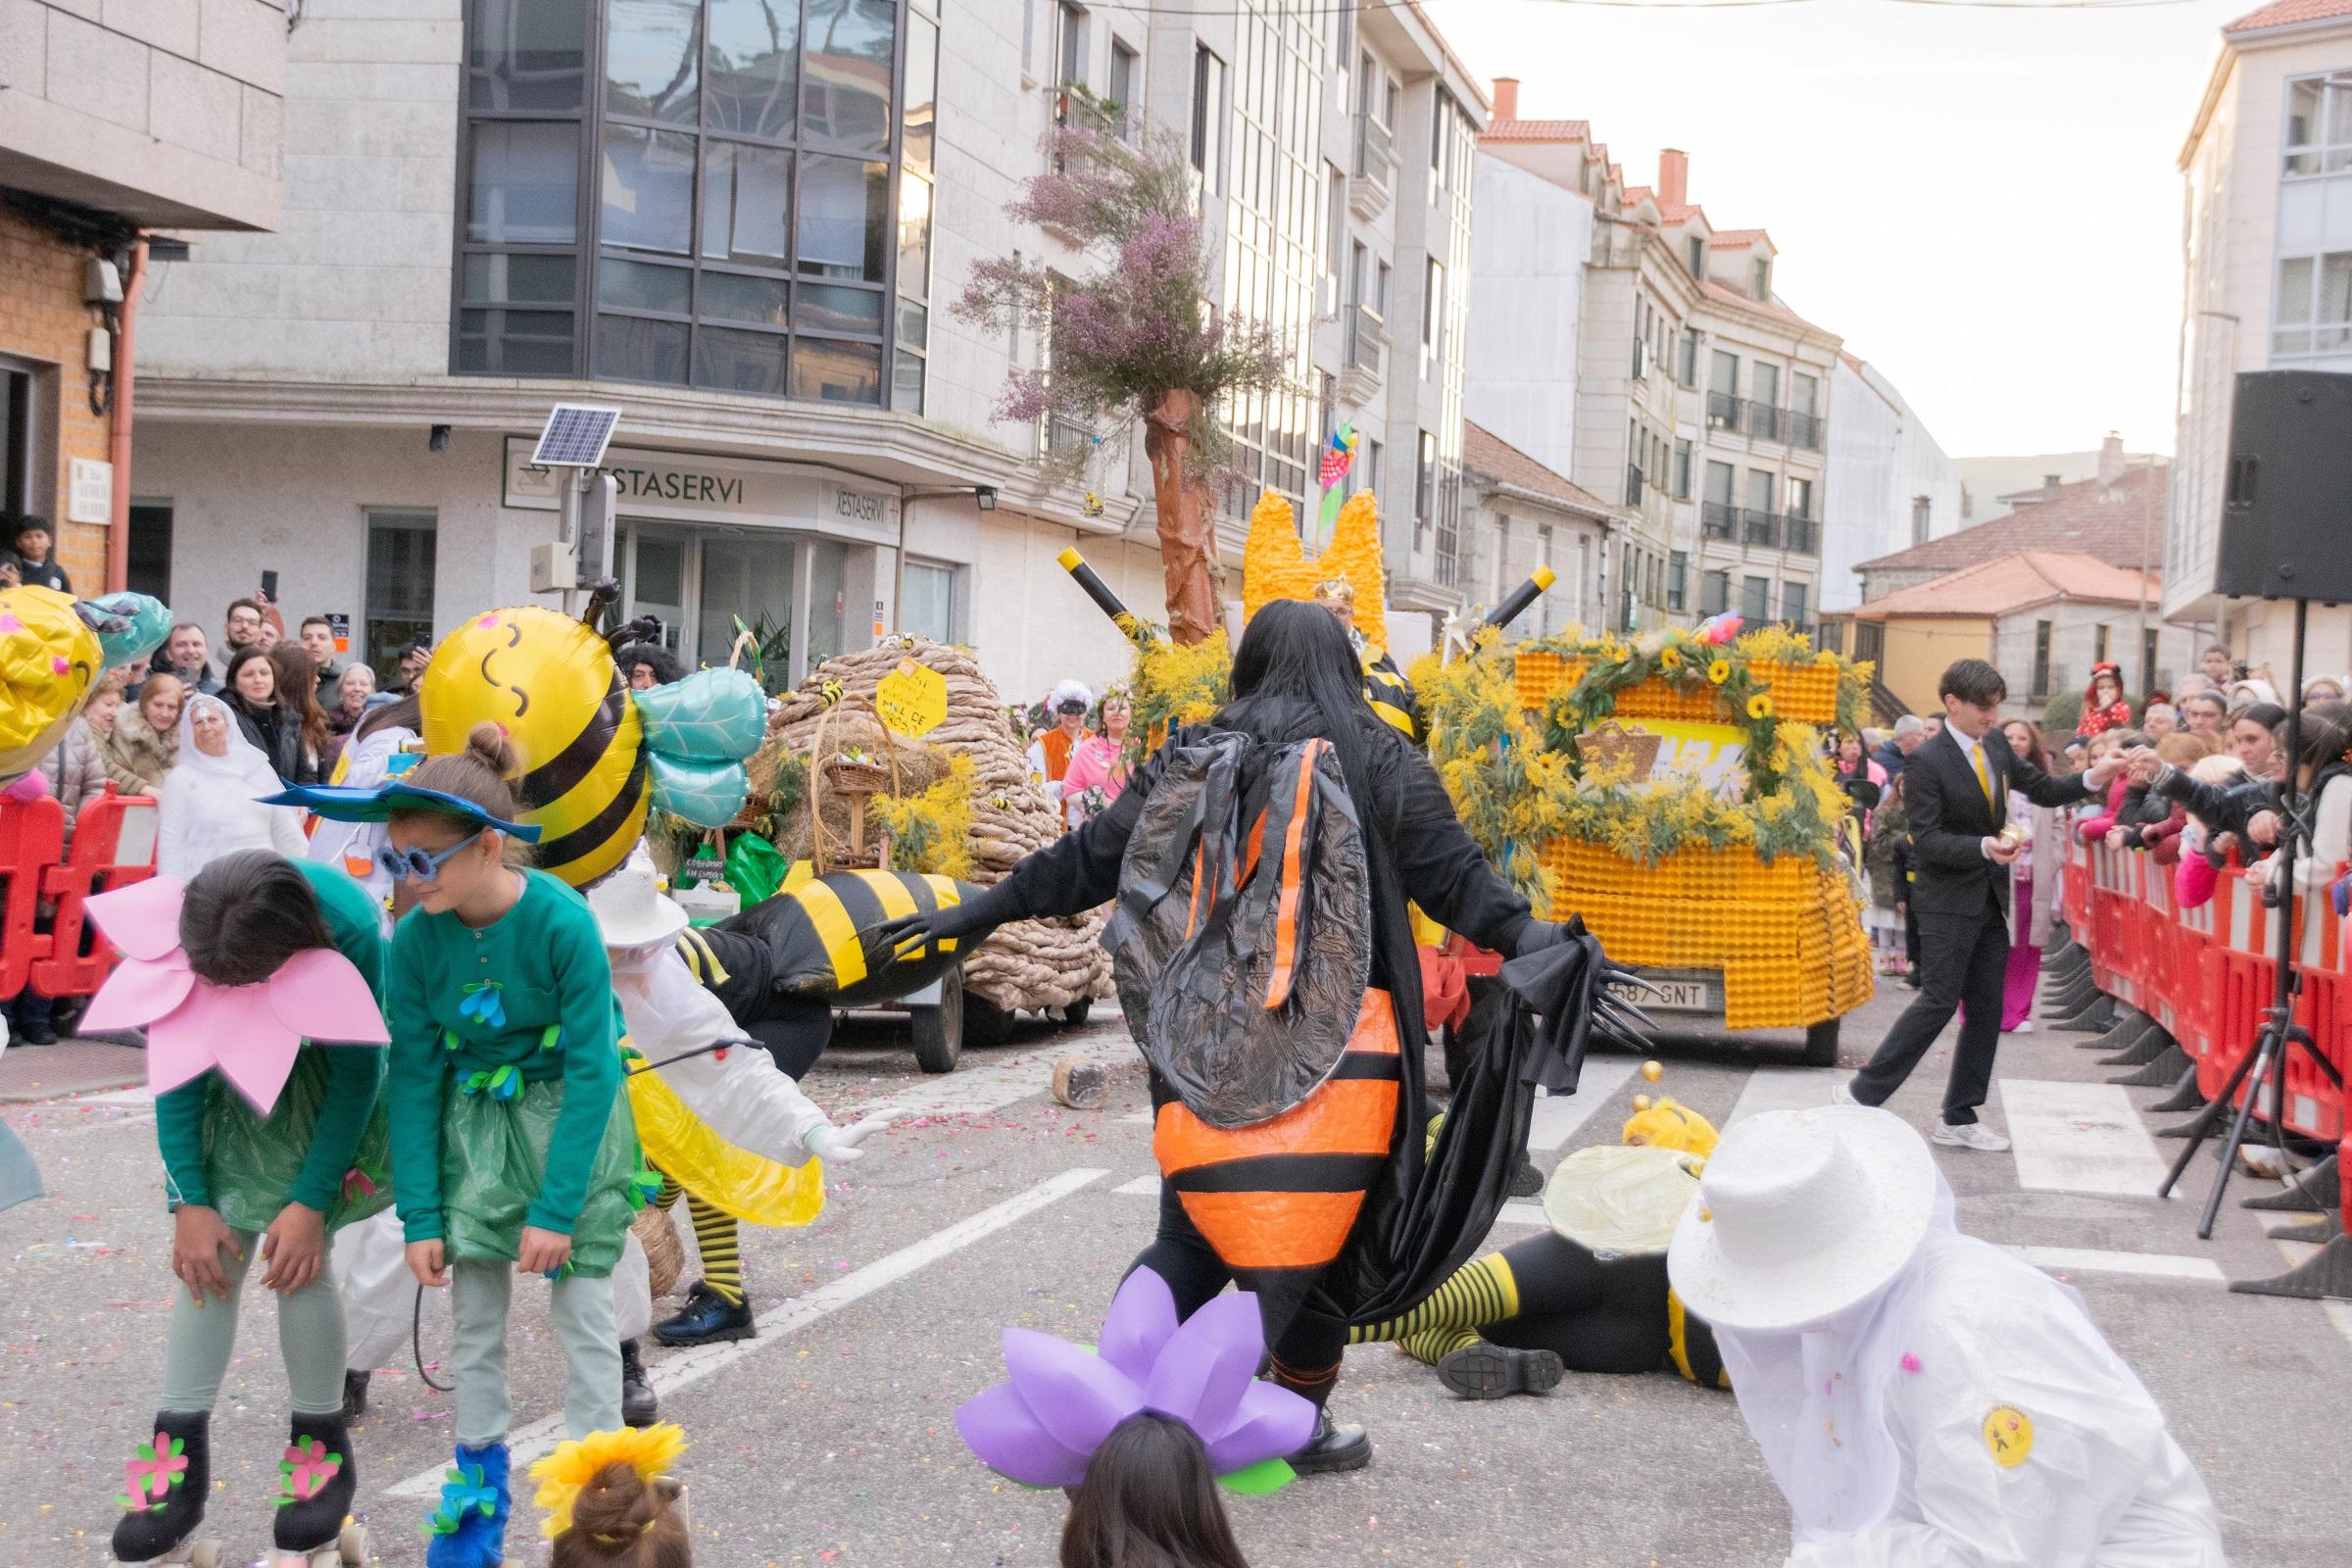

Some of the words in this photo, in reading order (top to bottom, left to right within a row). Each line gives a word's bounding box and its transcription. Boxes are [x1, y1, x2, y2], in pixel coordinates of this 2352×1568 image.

[836, 487, 884, 523] XESTASERVI
[911, 711, 926, 726] DE
[1661, 984, 1700, 1004] GNT
